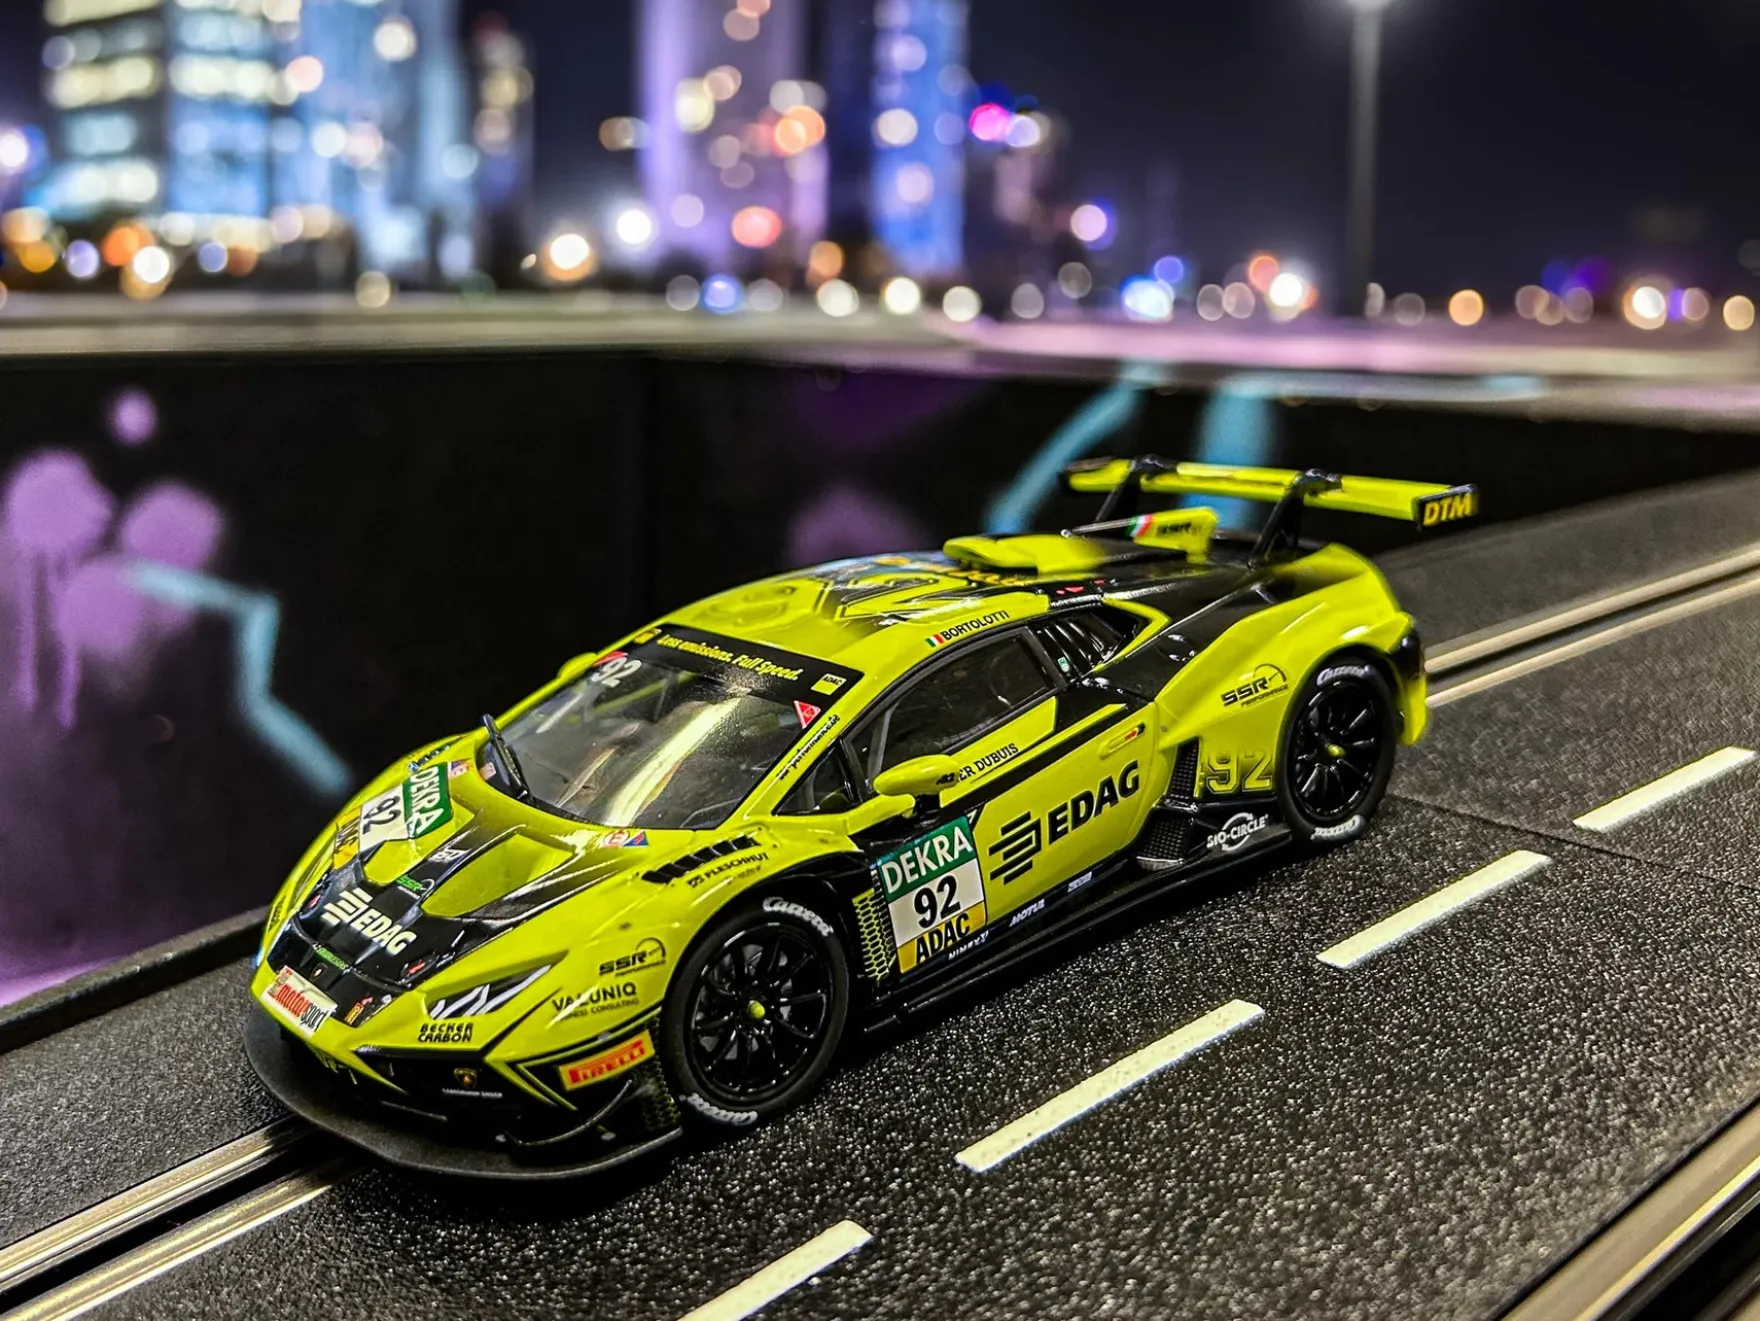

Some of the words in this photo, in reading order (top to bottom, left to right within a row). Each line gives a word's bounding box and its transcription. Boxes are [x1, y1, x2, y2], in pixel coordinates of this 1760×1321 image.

[1423, 492, 1476, 526] DTM
[941, 610, 1010, 642] BORTOLOTTI
[593, 657, 643, 688] 92
[656, 633, 682, 649] Less
[678, 640, 733, 662] emissions.
[731, 653, 760, 670] Full
[755, 660, 804, 682] Speed.
[1221, 676, 1269, 707] SSR
[973, 742, 1019, 772] DUBUIS
[1205, 751, 1272, 794] 92
[361, 795, 402, 836] 92
[408, 765, 445, 838] DEKRA
[1048, 759, 1140, 845] EDAG
[880, 826, 974, 894] DEKRA
[913, 874, 961, 930] 92
[350, 907, 418, 956] EDAG
[915, 912, 971, 965] ADAC
[599, 951, 647, 976] SSR
[418, 1033, 472, 1043] CARBON
[420, 1022, 474, 1033] BECKER
[568, 1039, 646, 1085] PIRELLI
